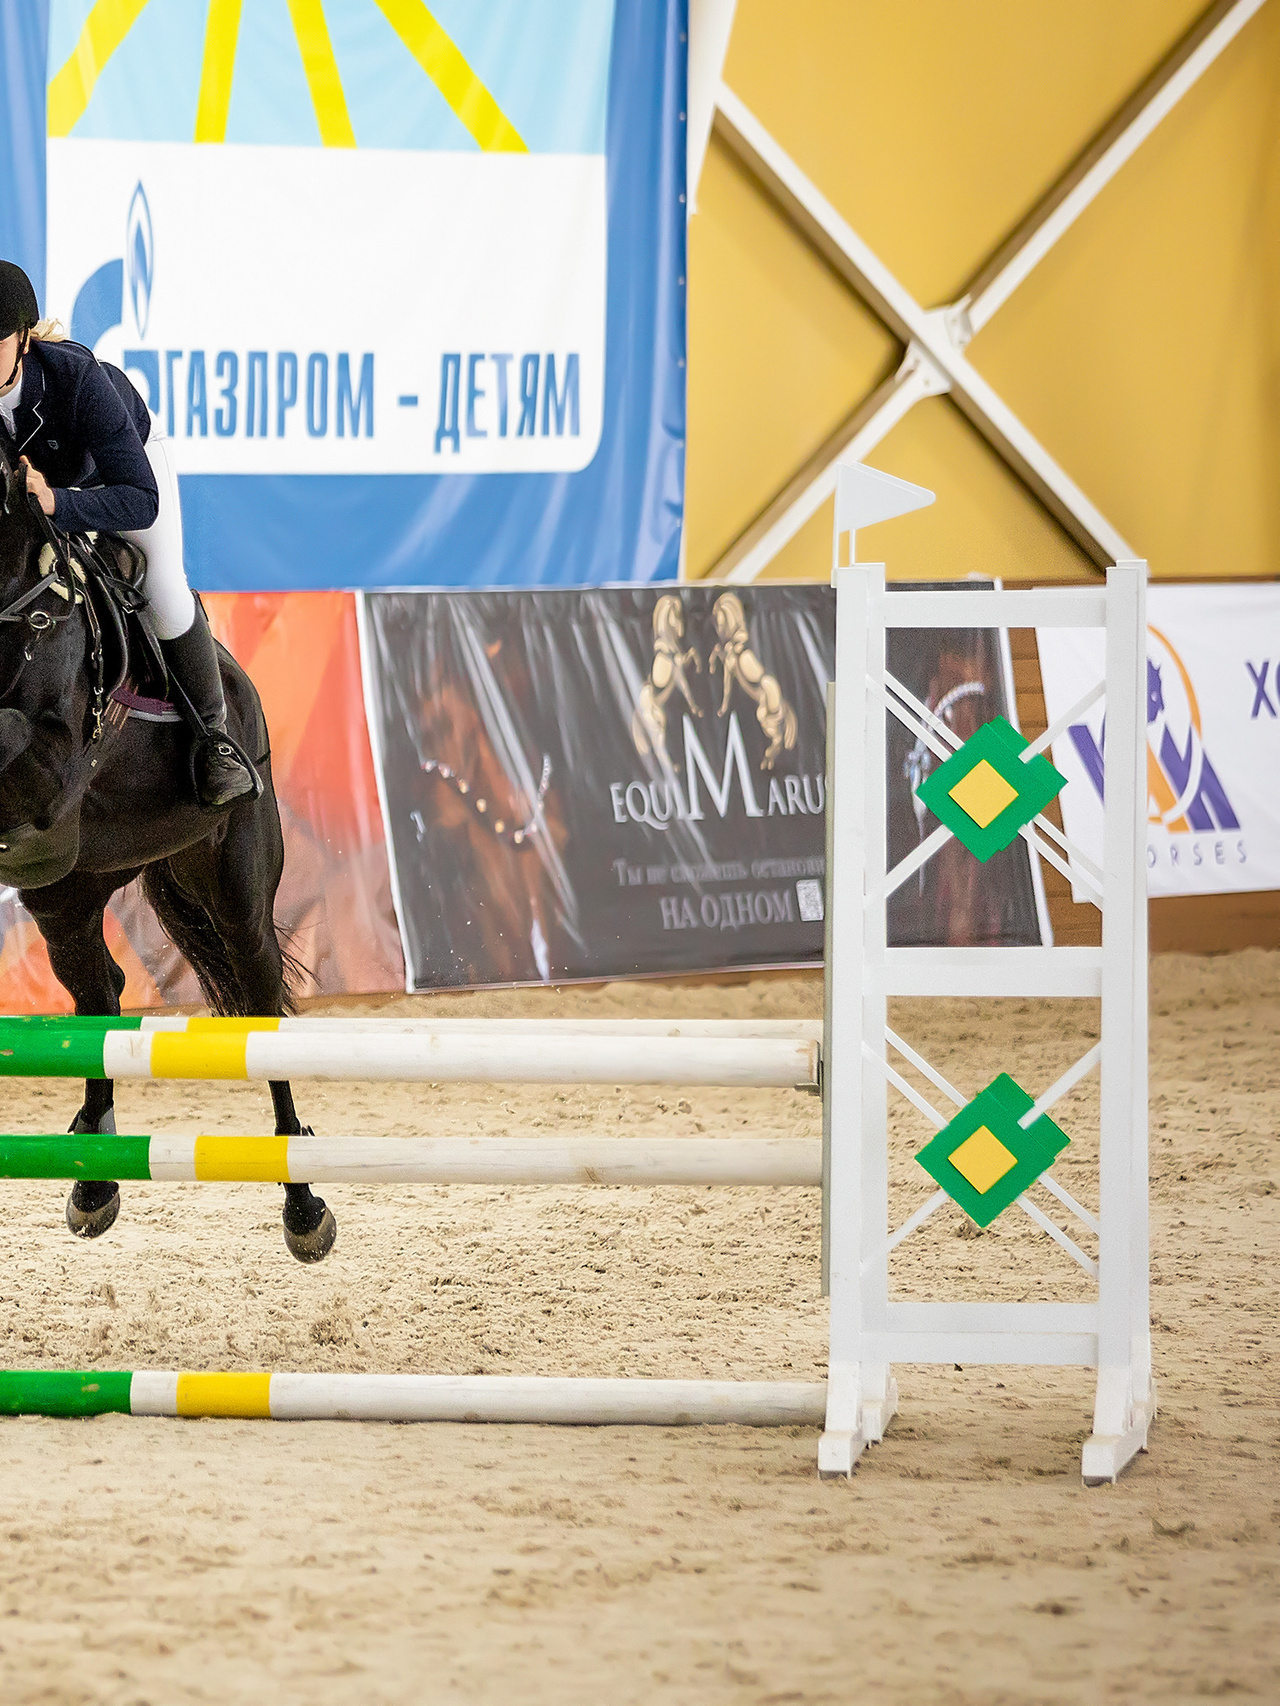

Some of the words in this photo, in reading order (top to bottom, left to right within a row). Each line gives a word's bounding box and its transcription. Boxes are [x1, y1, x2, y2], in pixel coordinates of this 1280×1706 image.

[166, 349, 375, 439] ГАЗПРОМ
[433, 352, 581, 455] ДЕТЯМ
[609, 710, 827, 830] EQUIMARU
[660, 896, 699, 931] НА
[700, 888, 794, 932] ОДНОМ
